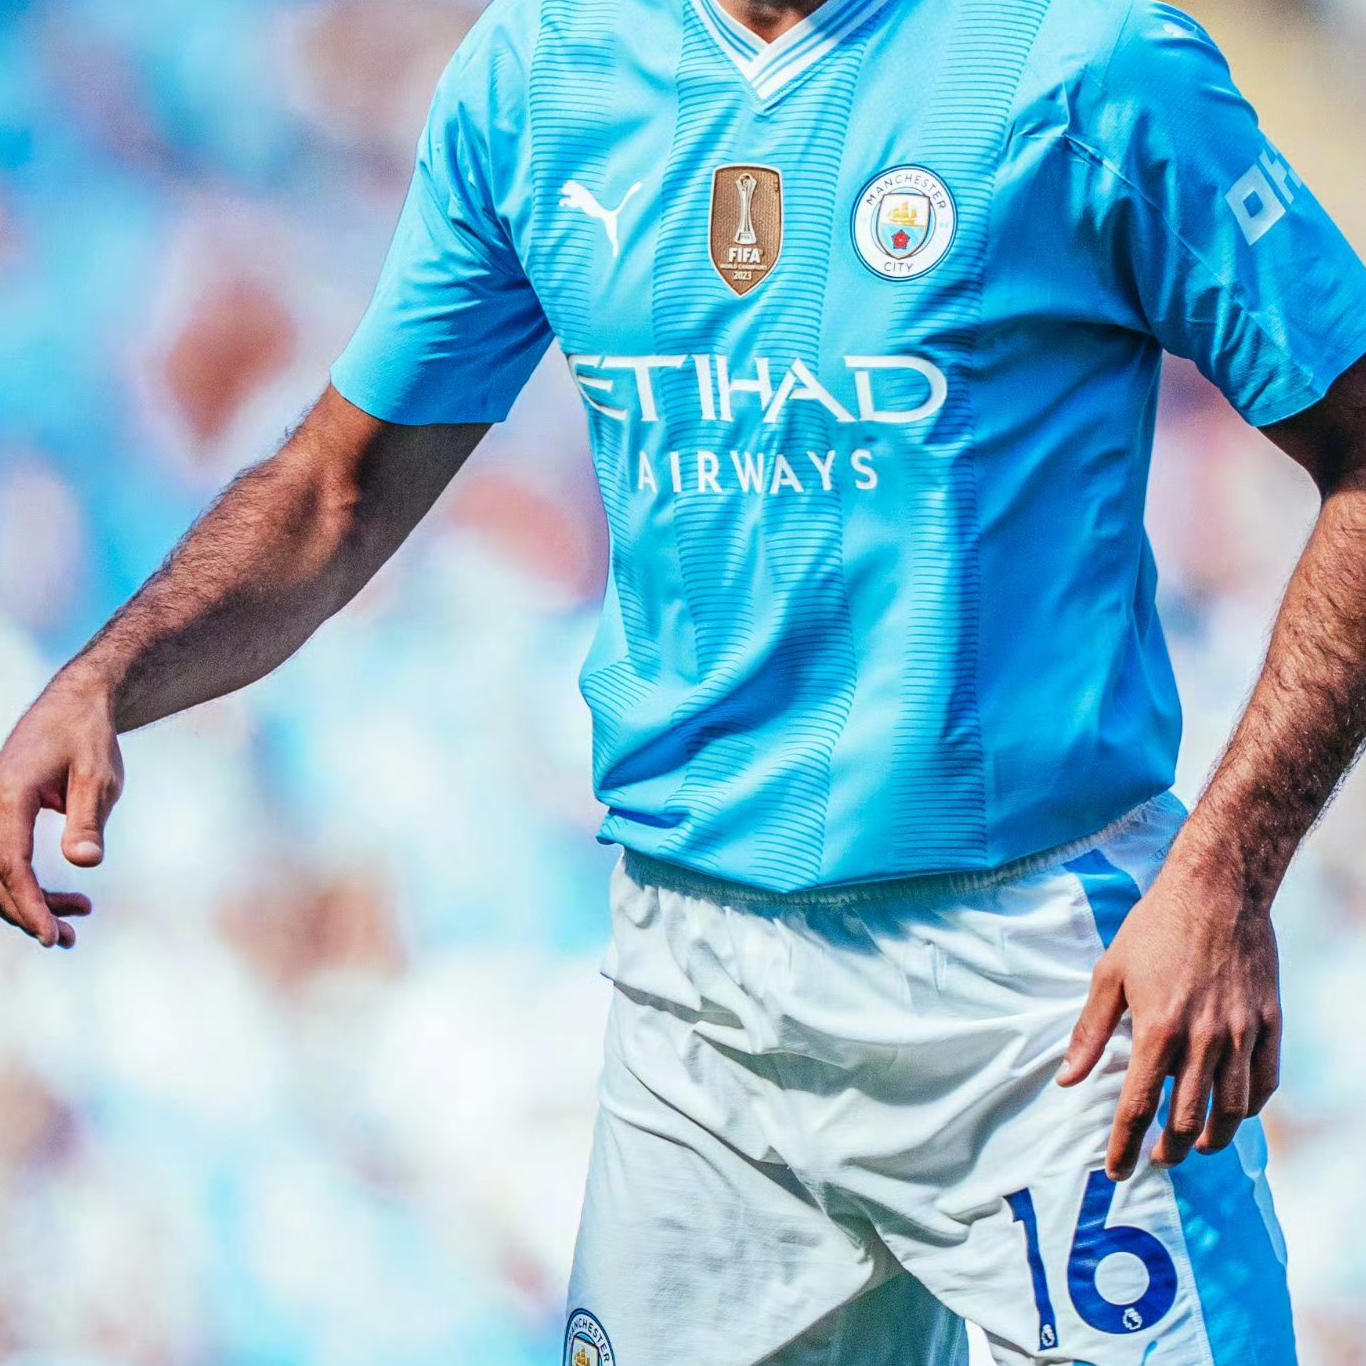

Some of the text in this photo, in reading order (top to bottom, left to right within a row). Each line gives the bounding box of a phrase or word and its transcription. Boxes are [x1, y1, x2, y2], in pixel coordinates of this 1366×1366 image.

[866, 173, 947, 210] MANCHESTER
[729, 247, 761, 263] FIFA
[883, 261, 914, 273] CITY
[733, 271, 752, 281] 2023
[568, 354, 948, 423] ETIHAD
[638, 448, 879, 495] AIRWAYS
[1002, 1167, 1179, 1352] 16
[568, 1317, 611, 1363] MANCHESTER
